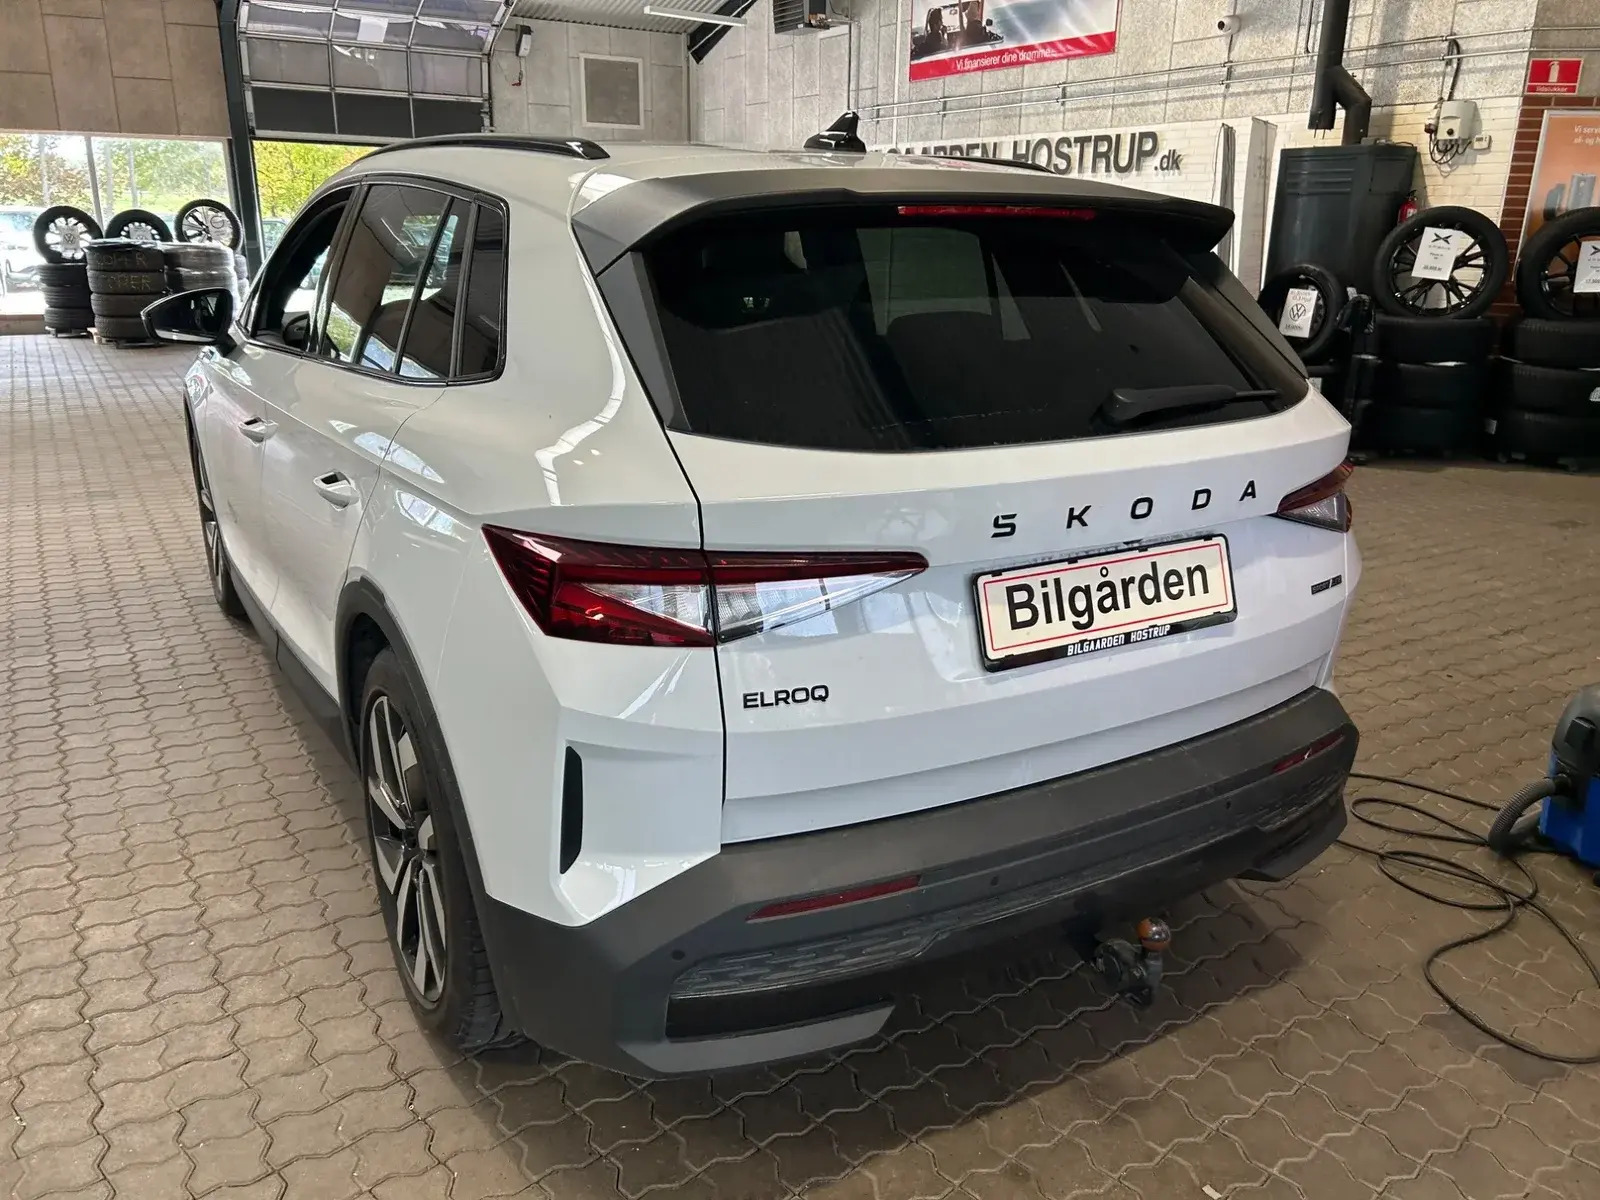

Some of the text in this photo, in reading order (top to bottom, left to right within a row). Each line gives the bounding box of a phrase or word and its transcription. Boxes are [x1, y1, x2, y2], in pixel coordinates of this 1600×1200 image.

[964, 54, 1000, 69] finansierer
[1002, 51, 1017, 64] dine
[991, 479, 1257, 538] SKODA
[1005, 561, 1210, 631] Bilgården
[1067, 624, 1171, 656] BILGAARDEN HOSTRUP
[742, 684, 830, 709] ELROQ
